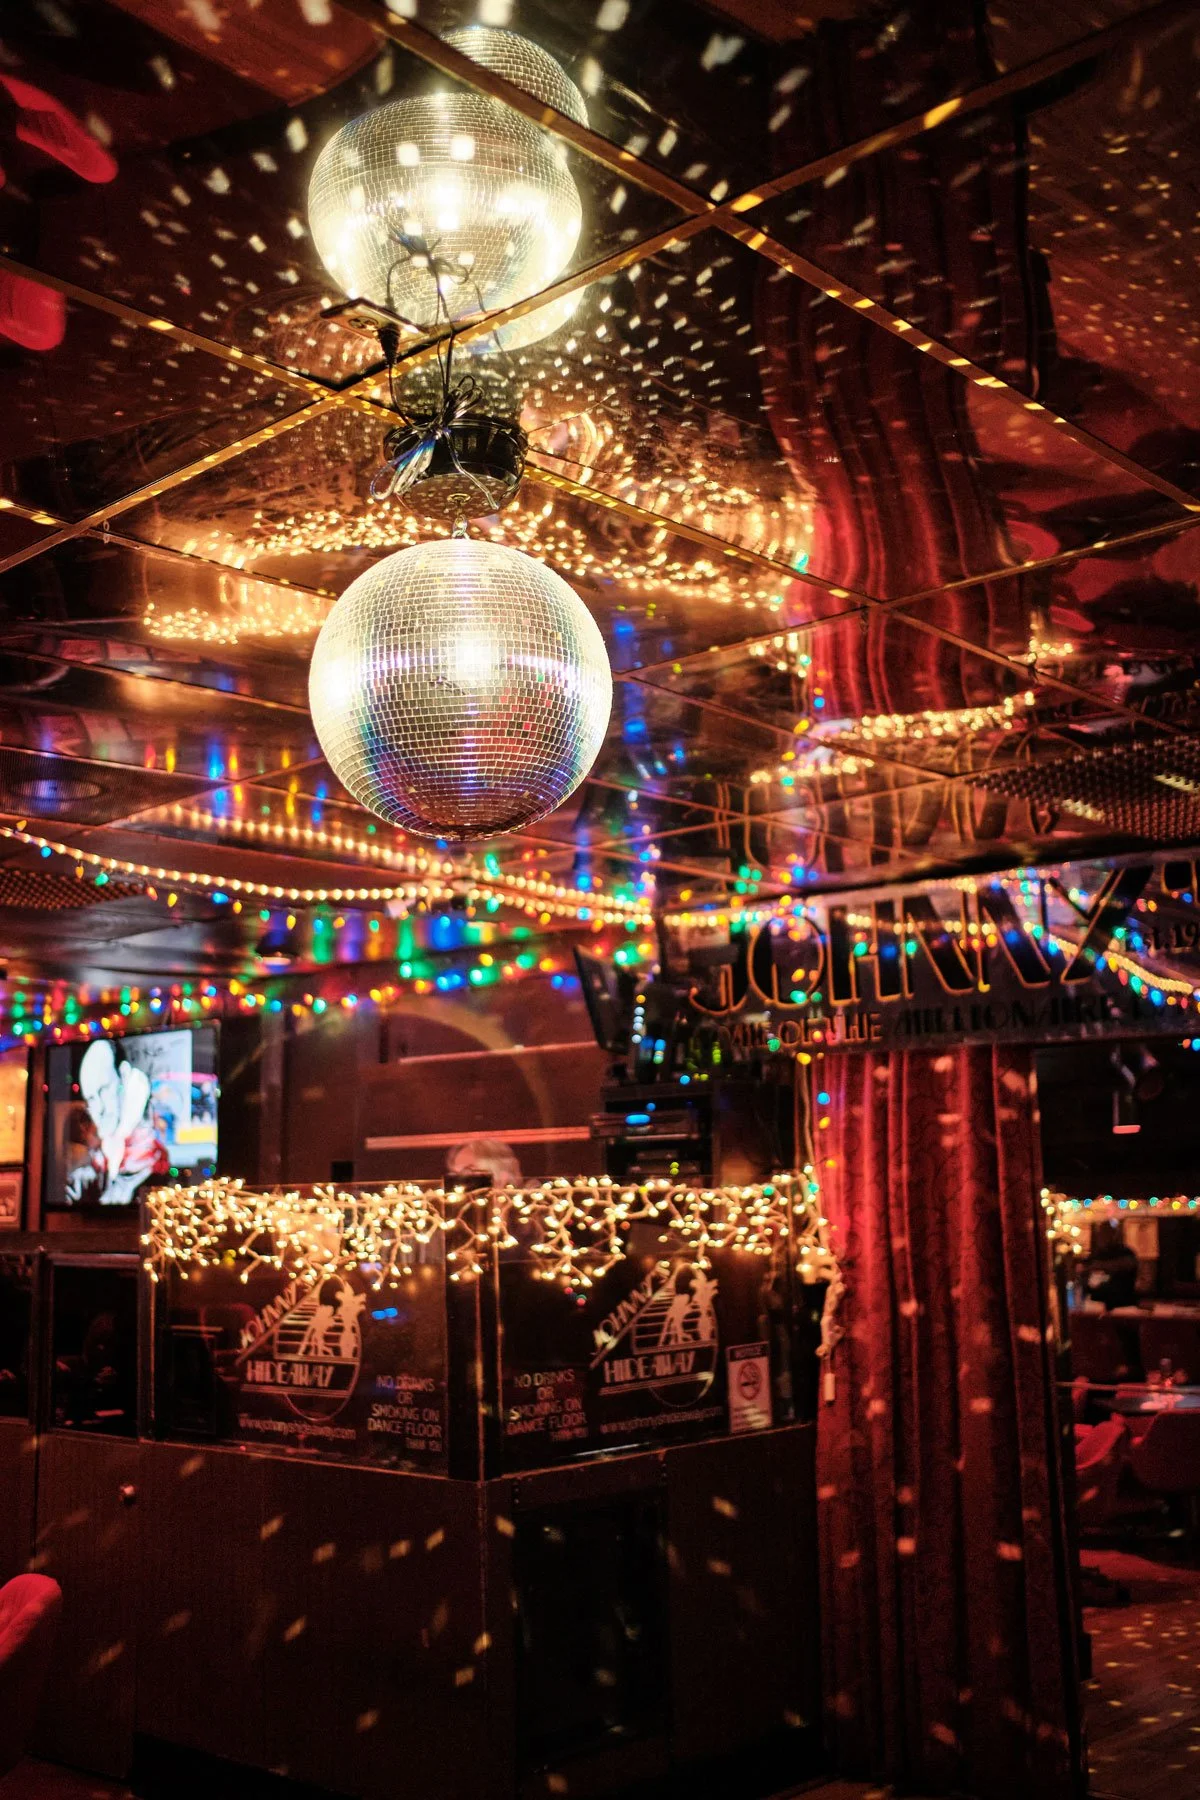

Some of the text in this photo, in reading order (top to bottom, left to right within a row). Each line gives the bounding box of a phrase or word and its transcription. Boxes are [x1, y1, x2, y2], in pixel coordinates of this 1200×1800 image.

[246, 1360, 335, 1388] HIDEAWAY
[603, 1351, 697, 1384] HIDEAWAY
[376, 1374, 394, 1389] NO
[397, 1391, 414, 1405] OR
[537, 1385, 555, 1401] OR
[371, 1403, 441, 1423] SMOKING ON
[367, 1417, 442, 1438] DANCE FLOOR
